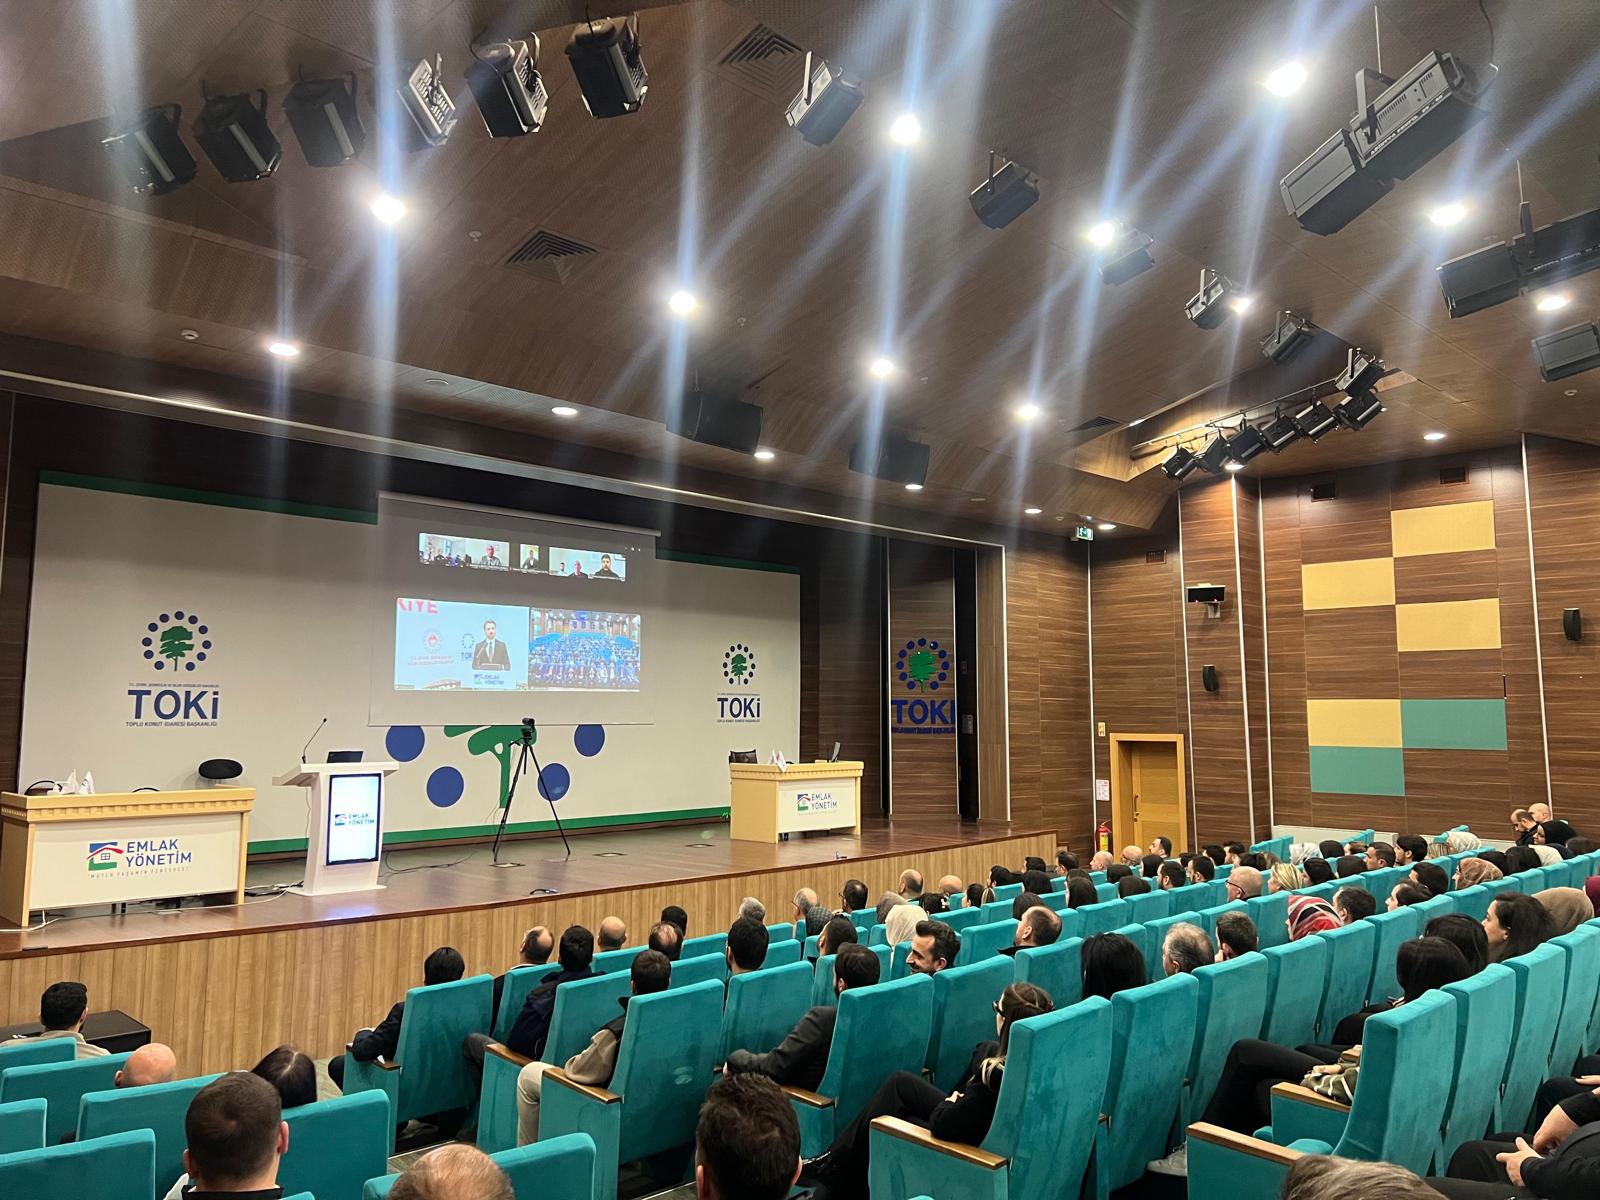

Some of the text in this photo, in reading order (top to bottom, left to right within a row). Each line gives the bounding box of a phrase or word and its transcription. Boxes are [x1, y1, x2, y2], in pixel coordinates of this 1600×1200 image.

[811, 793, 832, 801] EMLAK
[127, 839, 179, 853] EMLAK
[126, 851, 192, 867] YÖNETİM
